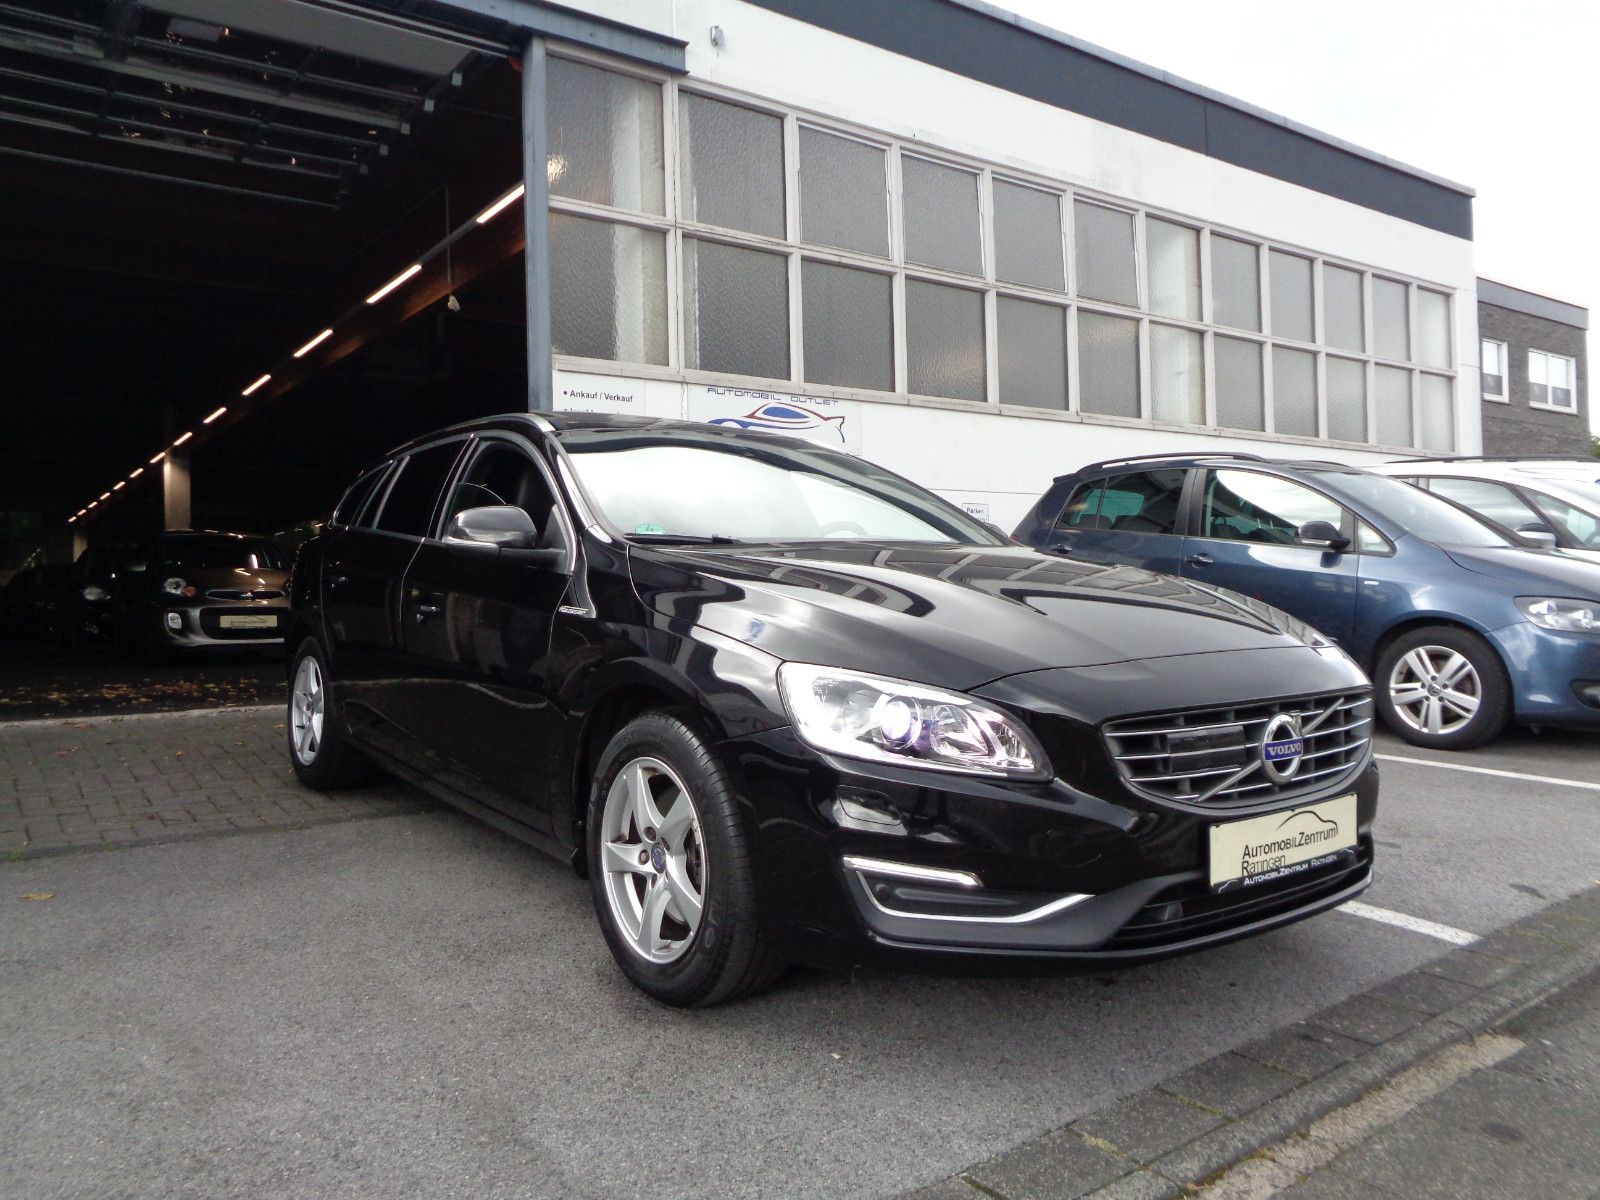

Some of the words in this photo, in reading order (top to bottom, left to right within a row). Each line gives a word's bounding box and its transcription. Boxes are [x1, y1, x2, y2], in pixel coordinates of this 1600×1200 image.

[570, 390, 598, 400] Ankauf
[604, 392, 633, 402] Verkauf
[707, 387, 781, 400] AUTOMOBIL
[791, 395, 839, 406] OUTLET
[966, 507, 985, 515] Parken
[1267, 742, 1302, 756] VOLVO
